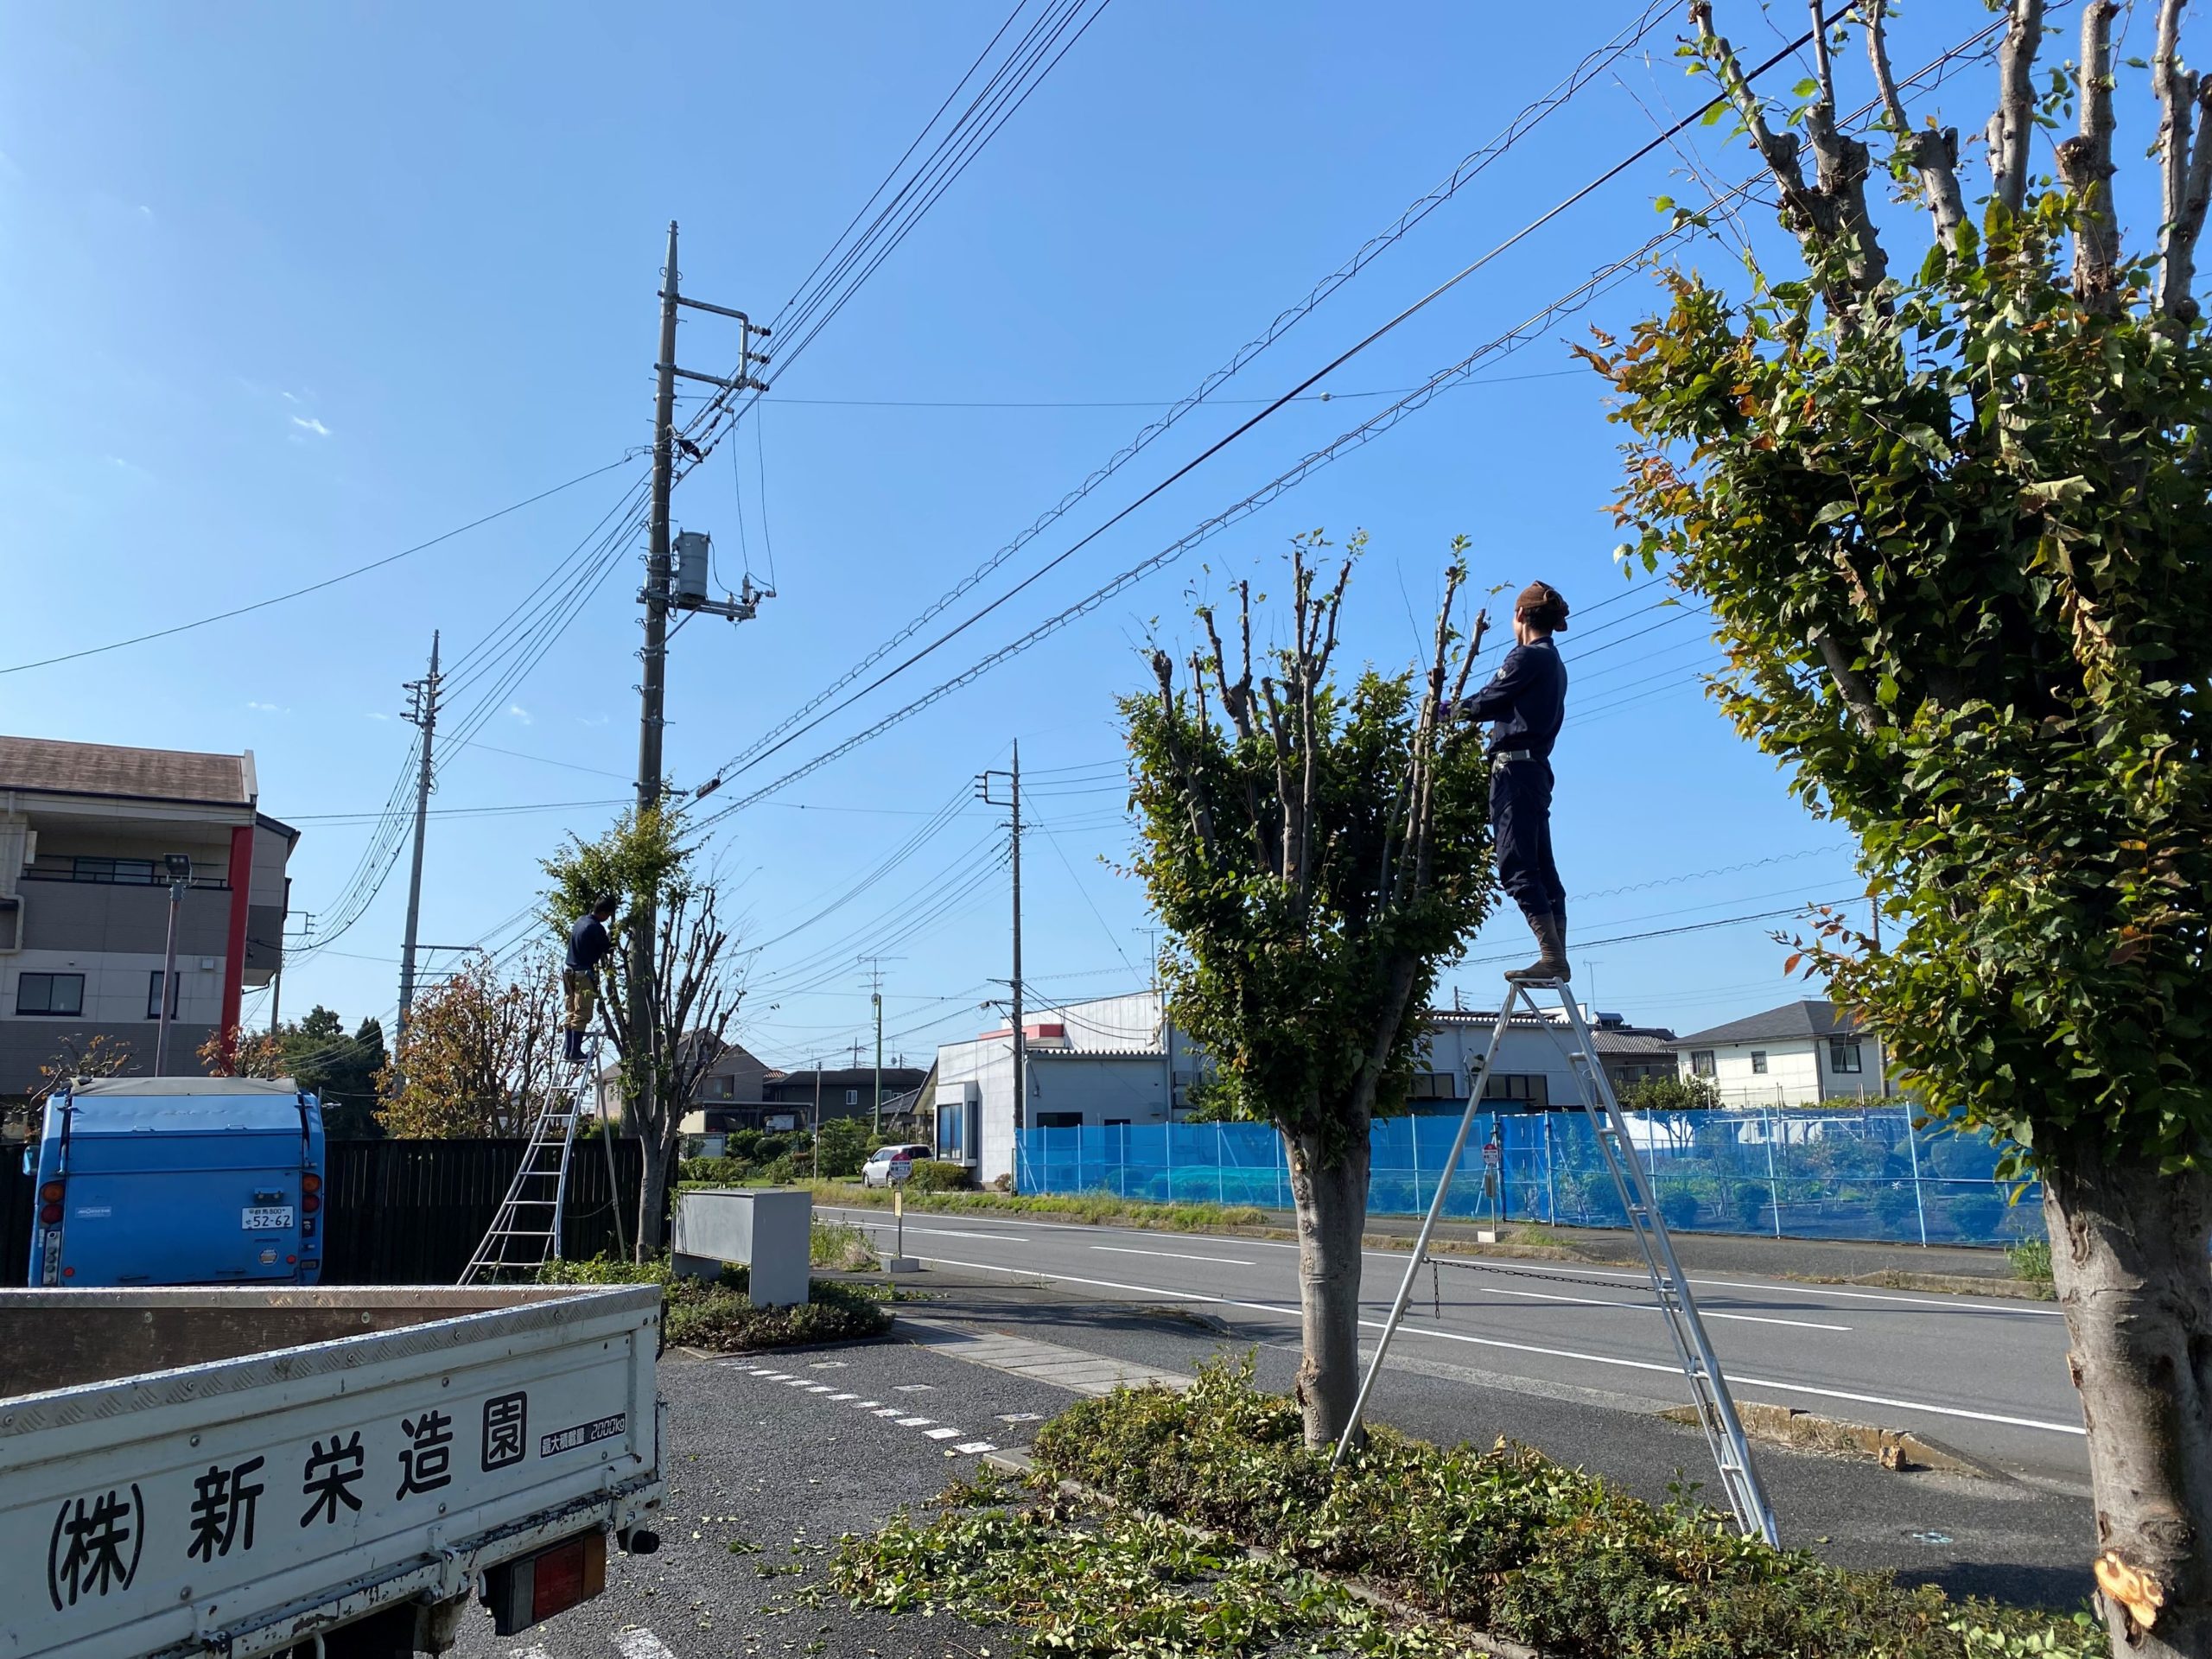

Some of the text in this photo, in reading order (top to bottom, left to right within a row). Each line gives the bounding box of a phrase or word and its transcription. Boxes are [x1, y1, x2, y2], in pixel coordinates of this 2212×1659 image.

[253, 1215, 290, 1227] 52-62
[542, 1418, 625, 1455] 最大積載量 2000kg
